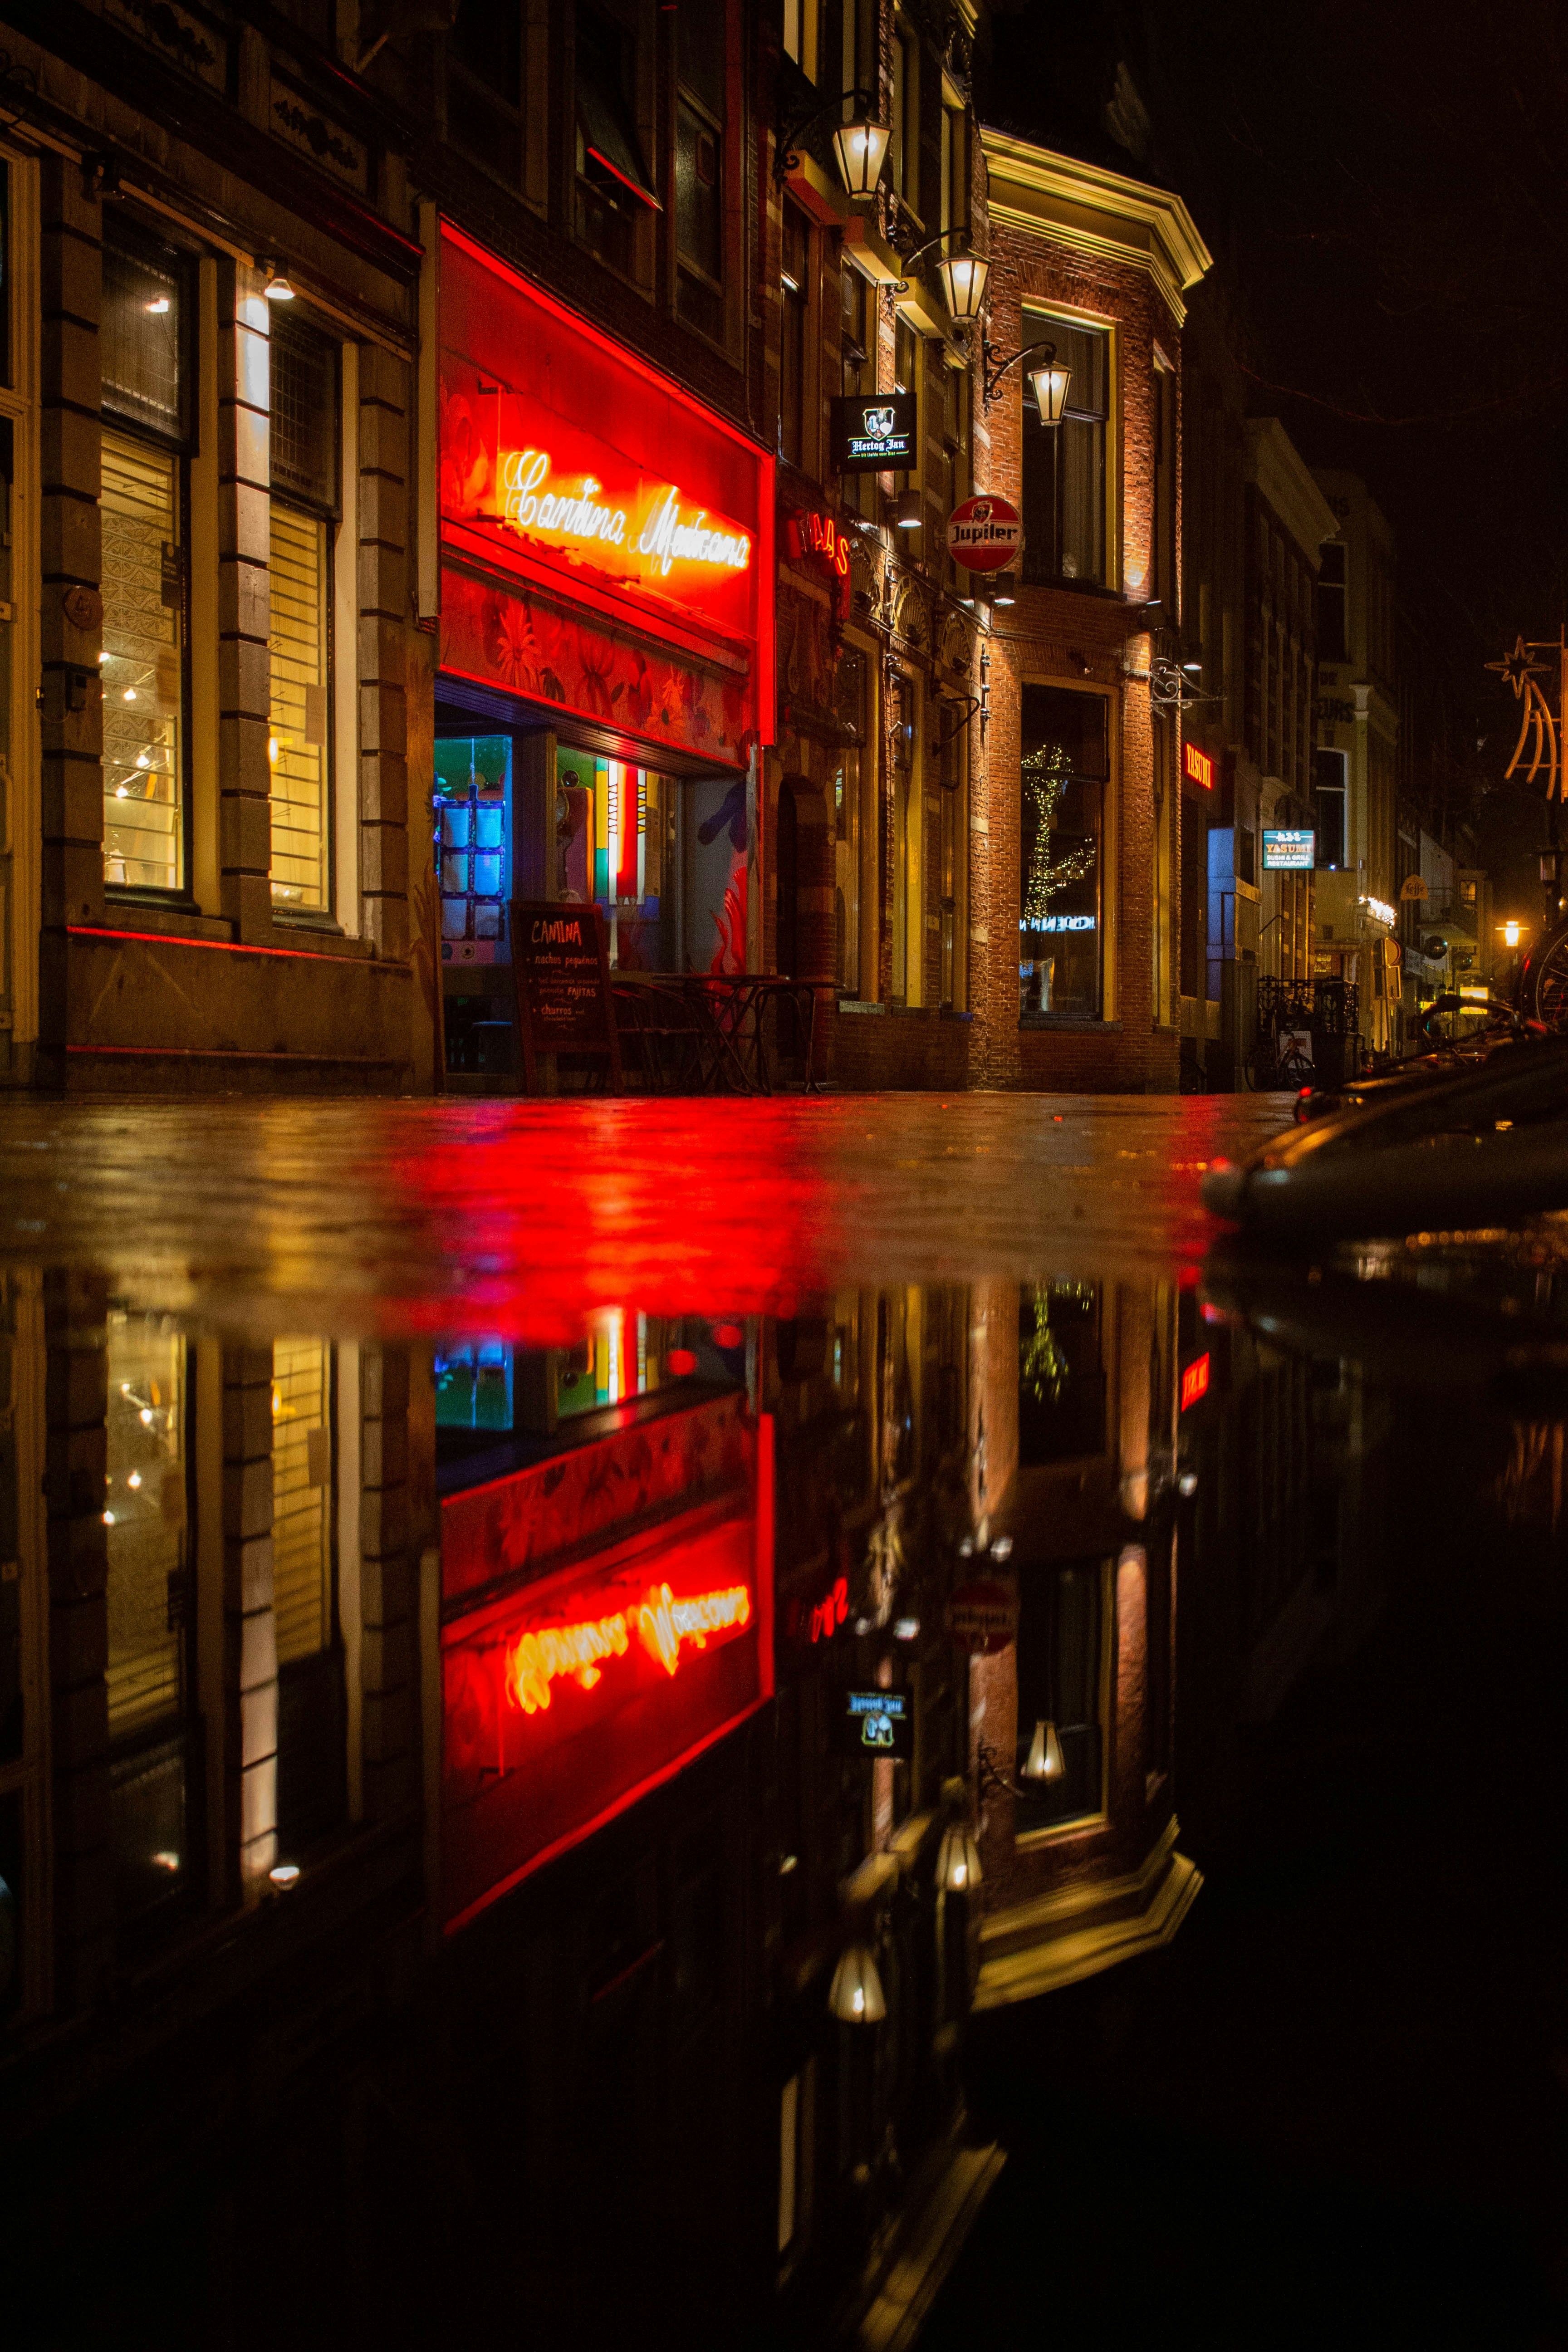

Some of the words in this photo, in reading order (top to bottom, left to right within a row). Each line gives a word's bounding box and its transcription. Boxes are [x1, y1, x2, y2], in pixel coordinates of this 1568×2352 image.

[852, 441, 884, 454] Hertog
[885, 438, 905, 453] Jan
[518, 450, 626, 546] Cantina
[639, 485, 750, 576] Mexicana
[952, 523, 1018, 545] Jupiler
[1186, 743, 1211, 789] YASUMI
[1266, 844, 1312, 853] YASUMI
[531, 920, 583, 947] CANTINA
[534, 951, 562, 965] nachos
[567, 986, 596, 1000] FAJITAS
[541, 1002, 572, 1015] churros
